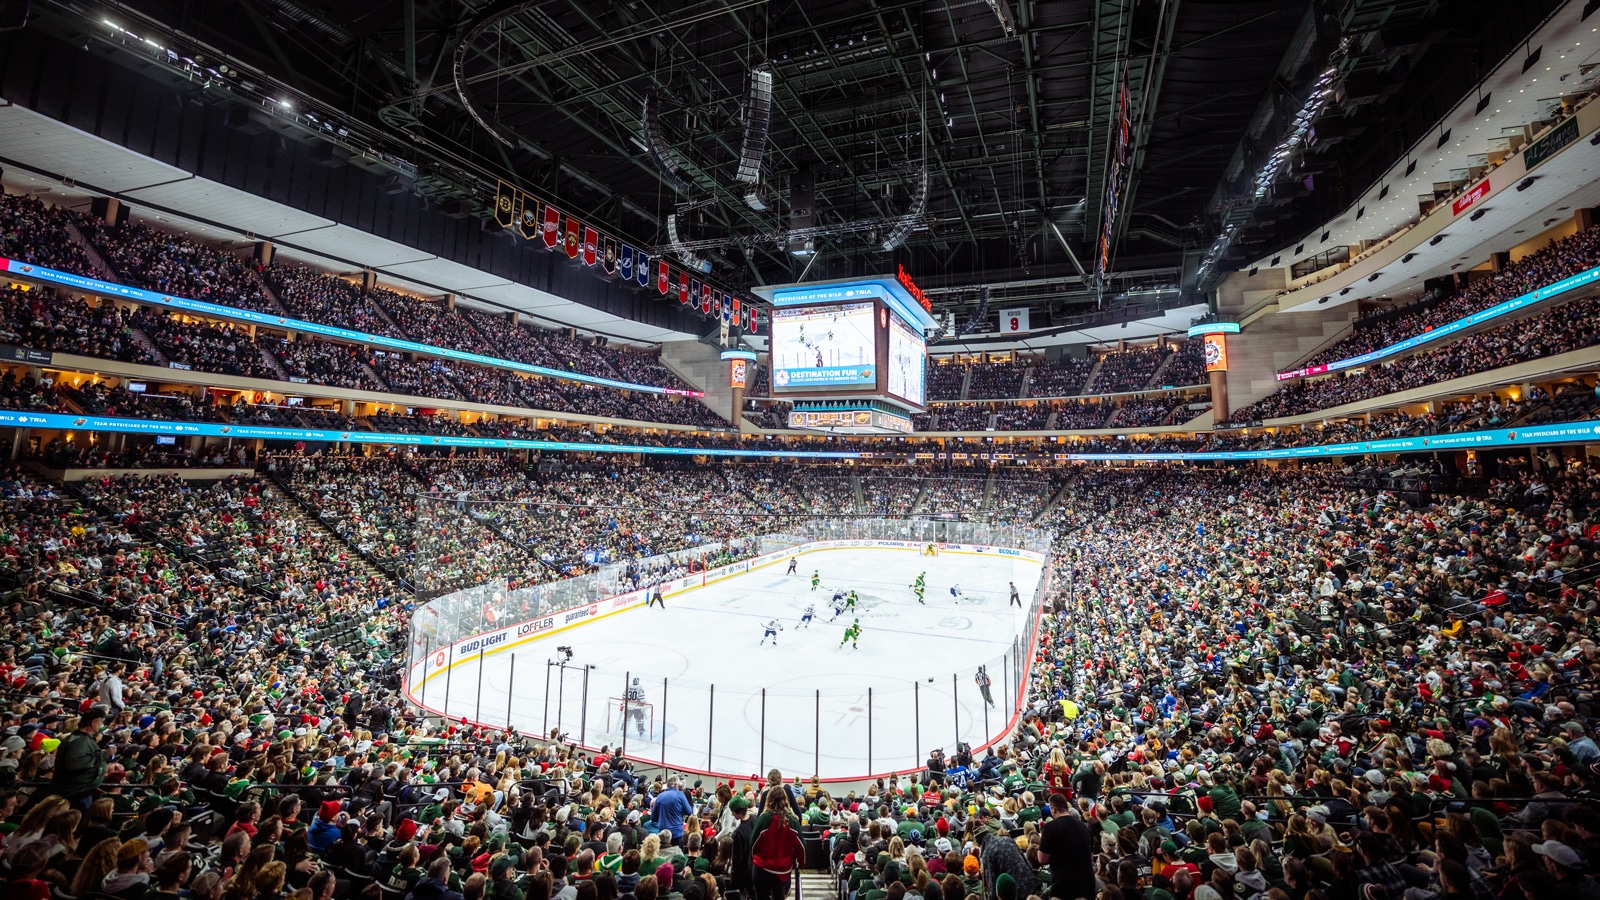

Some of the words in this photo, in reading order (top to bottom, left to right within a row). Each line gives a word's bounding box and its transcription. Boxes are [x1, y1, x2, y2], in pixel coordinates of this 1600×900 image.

[56, 274, 86, 285] PHYSICIANS
[1010, 317, 1019, 331] 9
[790, 370, 839, 379] DESTINATION
[841, 369, 858, 377] FUN
[998, 548, 1020, 556] ECOLAB
[565, 607, 590, 624] guaranteed
[517, 617, 554, 636] LOFFLER
[460, 642, 480, 655] BUD
[480, 632, 507, 648] LIGHT
[628, 691, 638, 701] 30
